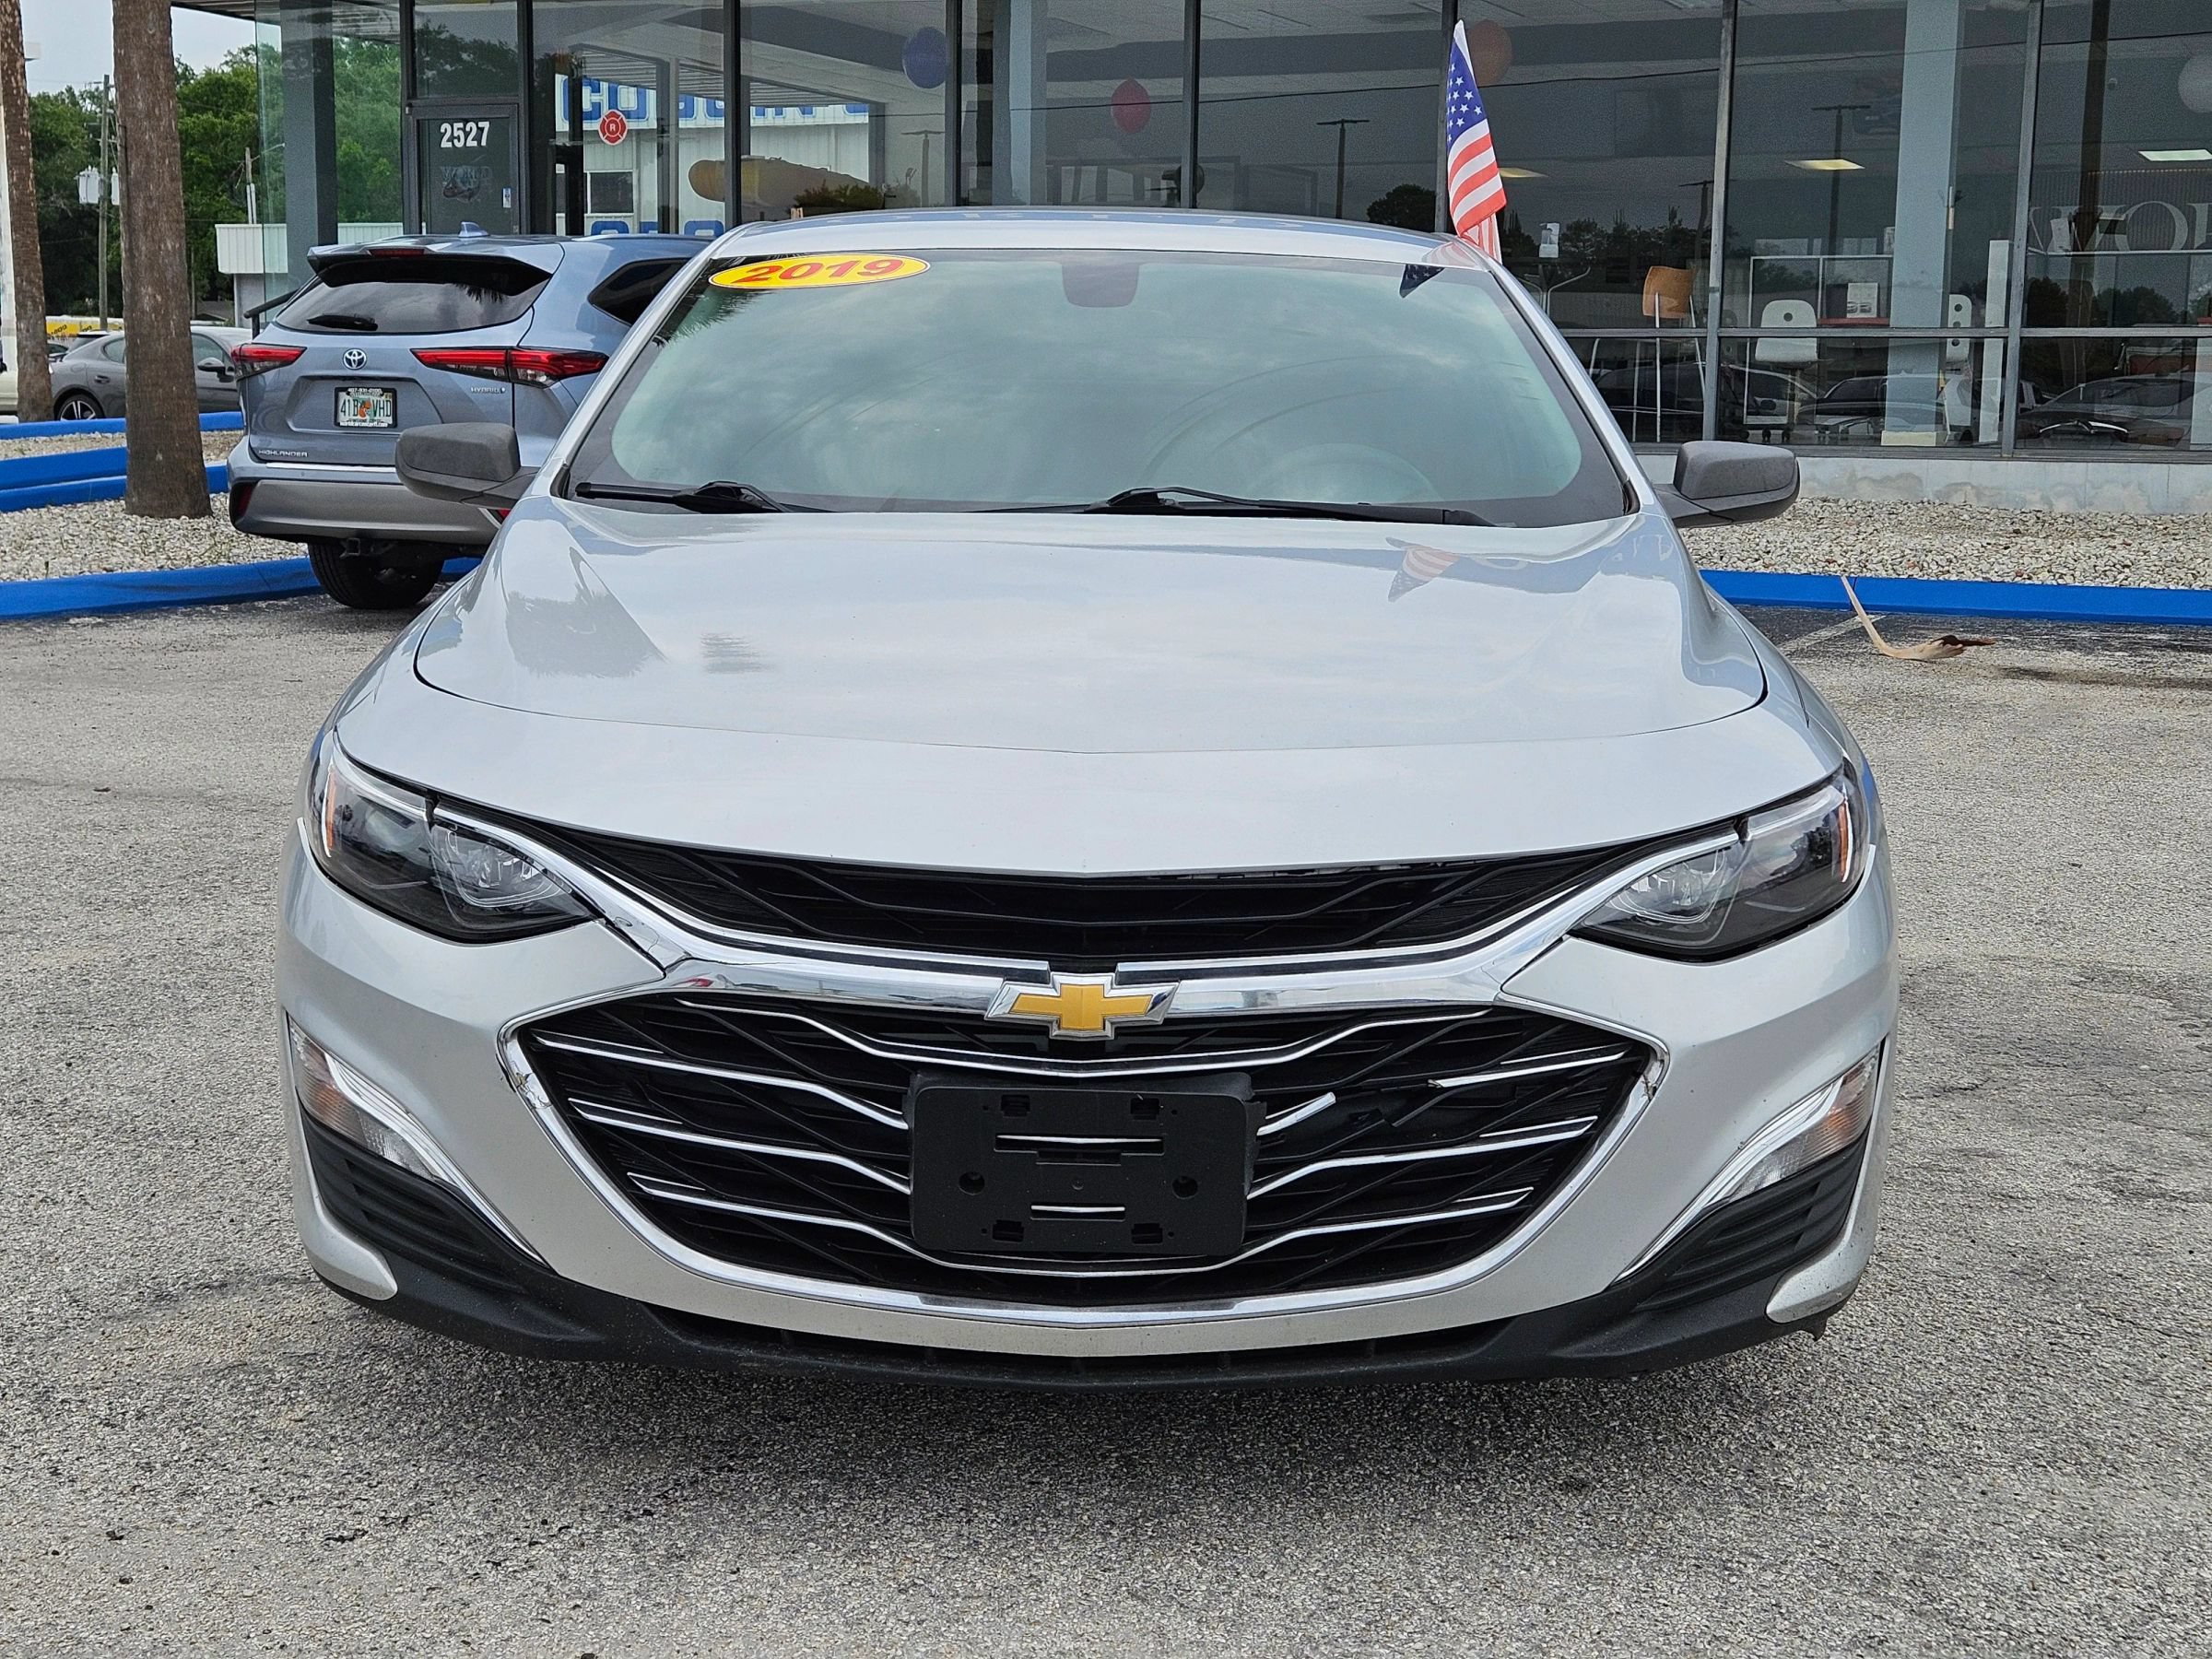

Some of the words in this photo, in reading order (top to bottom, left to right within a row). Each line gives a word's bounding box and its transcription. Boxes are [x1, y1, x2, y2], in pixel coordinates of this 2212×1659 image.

[440, 121, 489, 147] 2527
[609, 124, 616, 132] R
[730, 259, 904, 284] 2019
[372, 399, 391, 417] VHD
